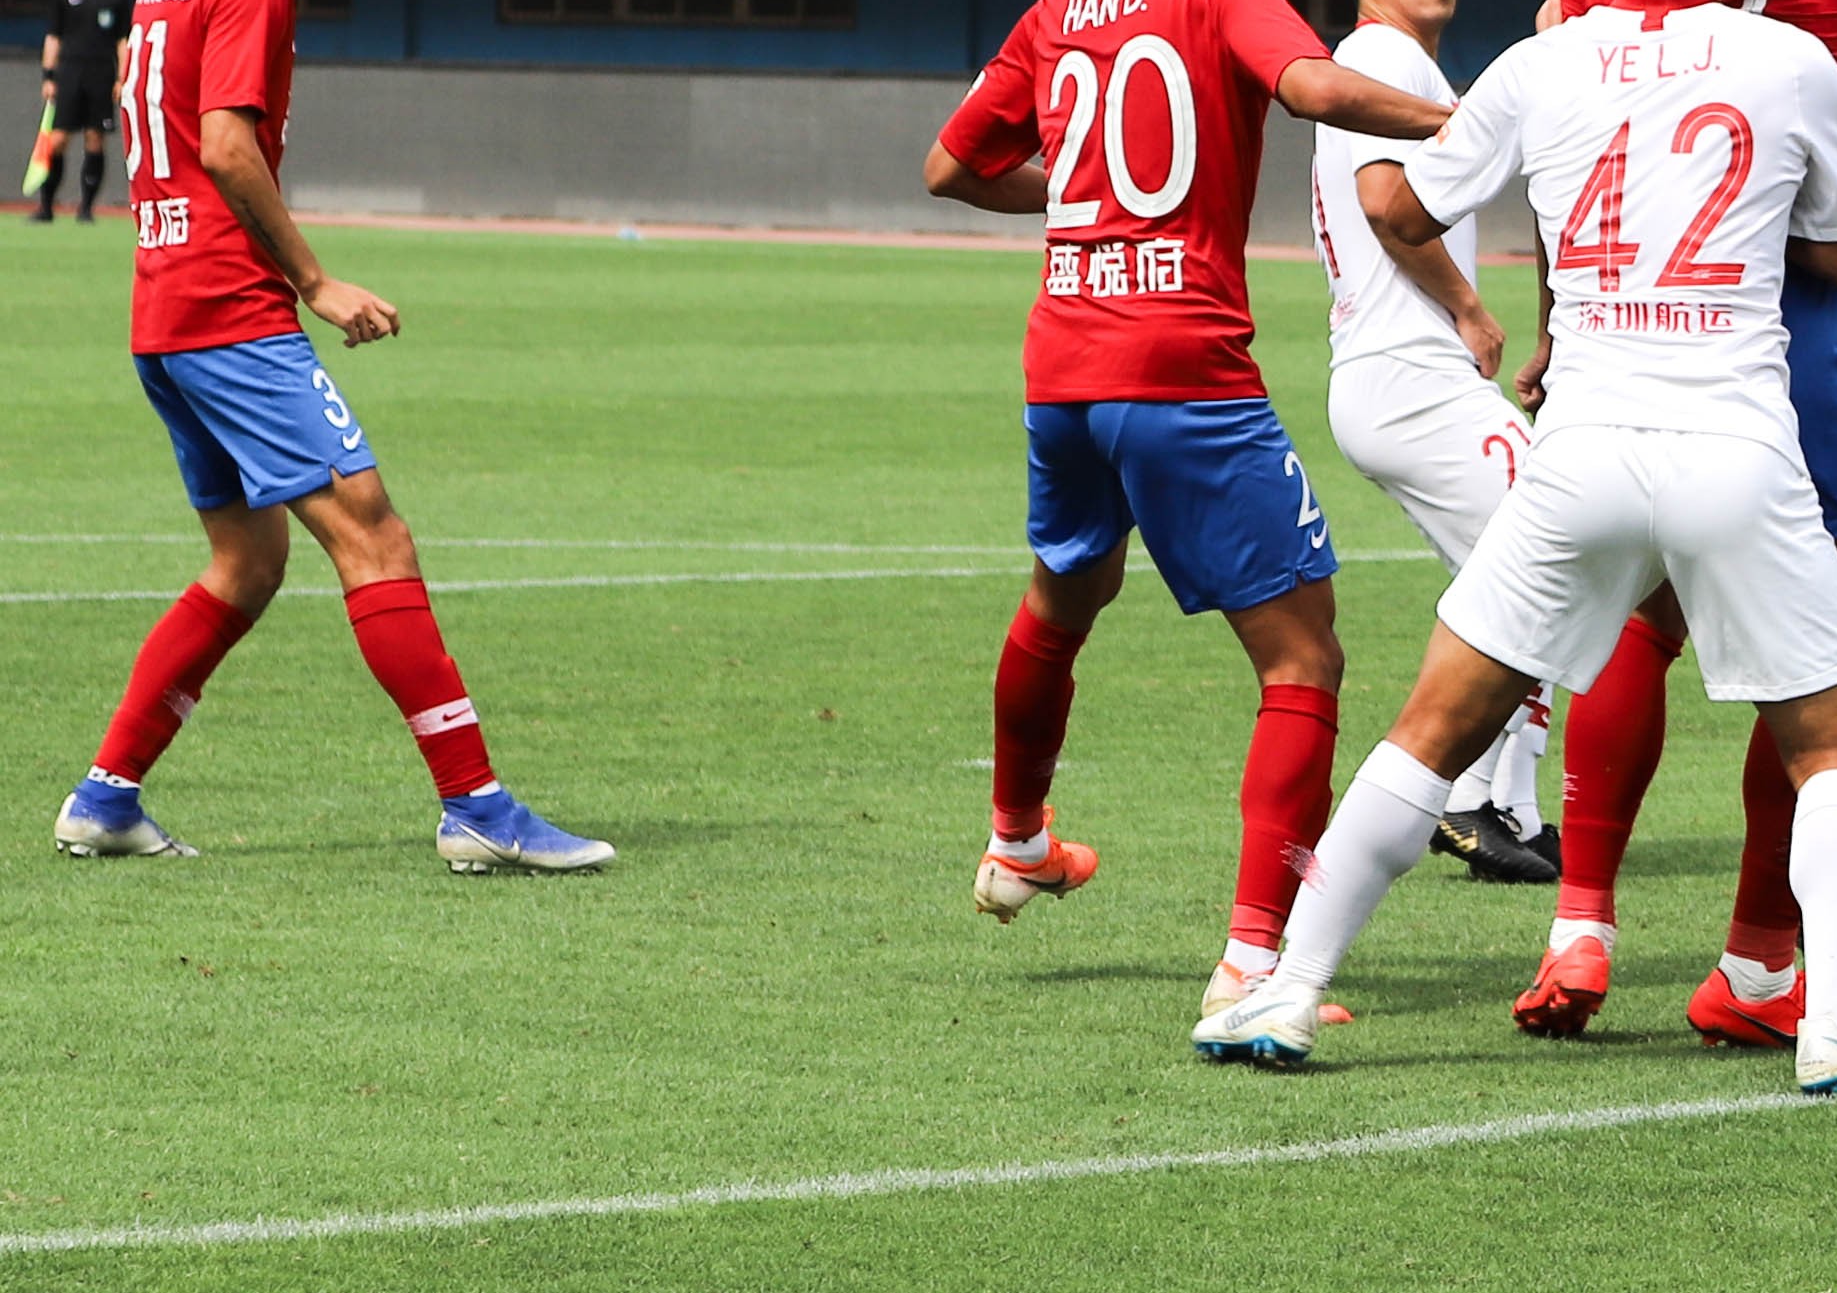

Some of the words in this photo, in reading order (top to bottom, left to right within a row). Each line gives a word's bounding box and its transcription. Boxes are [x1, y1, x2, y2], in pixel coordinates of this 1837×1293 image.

[1597, 45, 1641, 84] YE
[121, 20, 171, 181] 31
[1045, 33, 1197, 229] 20
[131, 197, 191, 250] 悦府
[1554, 102, 1754, 293] 42
[1044, 237, 1186, 298] 盛悦府
[1577, 301, 1736, 335] 深圳航运
[312, 368, 351, 430] 3
[1283, 450, 1321, 528] 2
